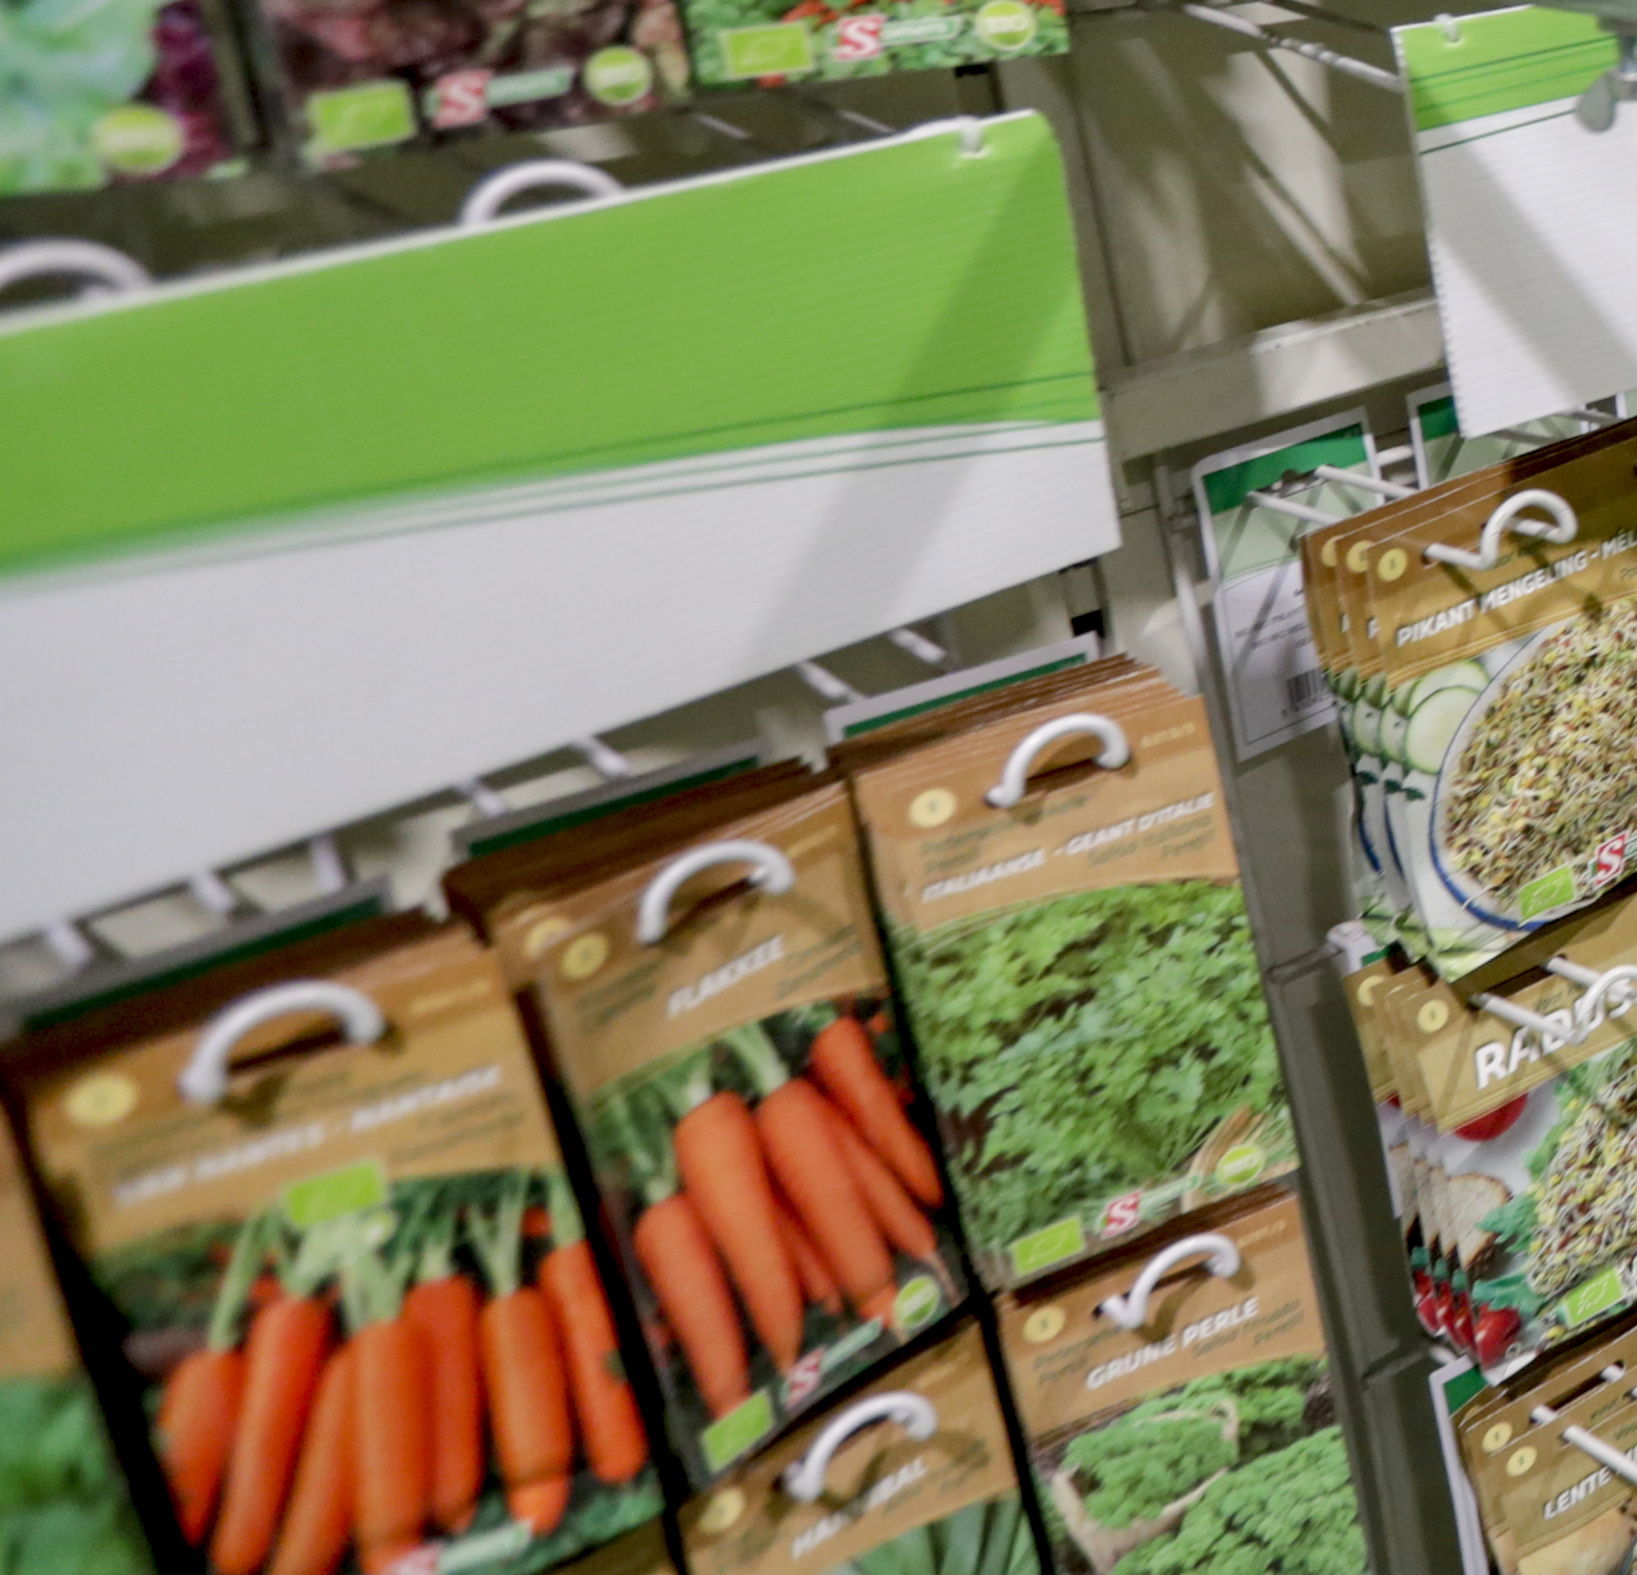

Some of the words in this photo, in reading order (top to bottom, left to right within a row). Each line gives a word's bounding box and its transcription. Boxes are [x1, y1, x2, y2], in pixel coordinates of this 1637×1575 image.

[1395, 598, 1476, 649] PIKANT
[1474, 987, 1635, 1090] RADS
[1181, 1298, 1258, 1348] PERLE
[1543, 1464, 1612, 1521] LENTE
